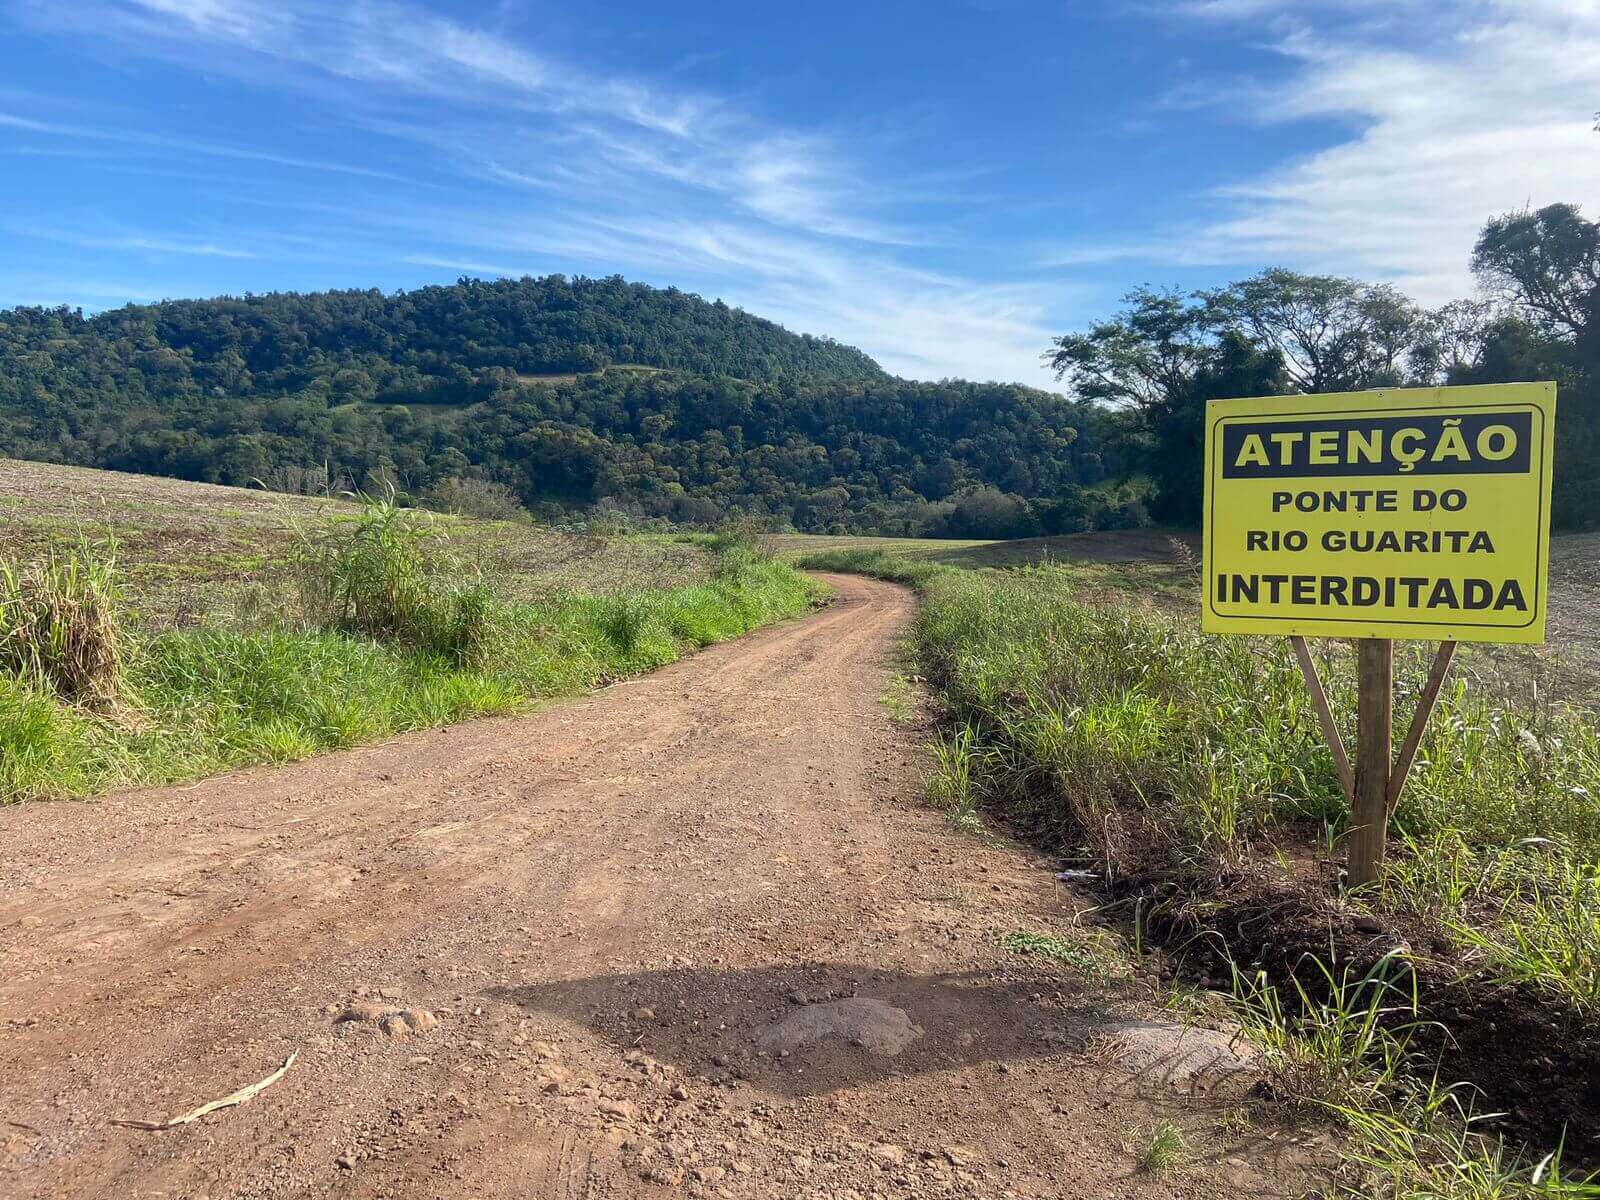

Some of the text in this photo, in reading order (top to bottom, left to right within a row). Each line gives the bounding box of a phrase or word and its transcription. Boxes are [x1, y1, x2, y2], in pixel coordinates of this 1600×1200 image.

[1234, 418, 1518, 472] ATENÇÃO
[1272, 489, 1468, 513] PONTE DO
[1246, 530, 1496, 553] RIO GUARITA
[1217, 574, 1528, 611] INTERDITADA
